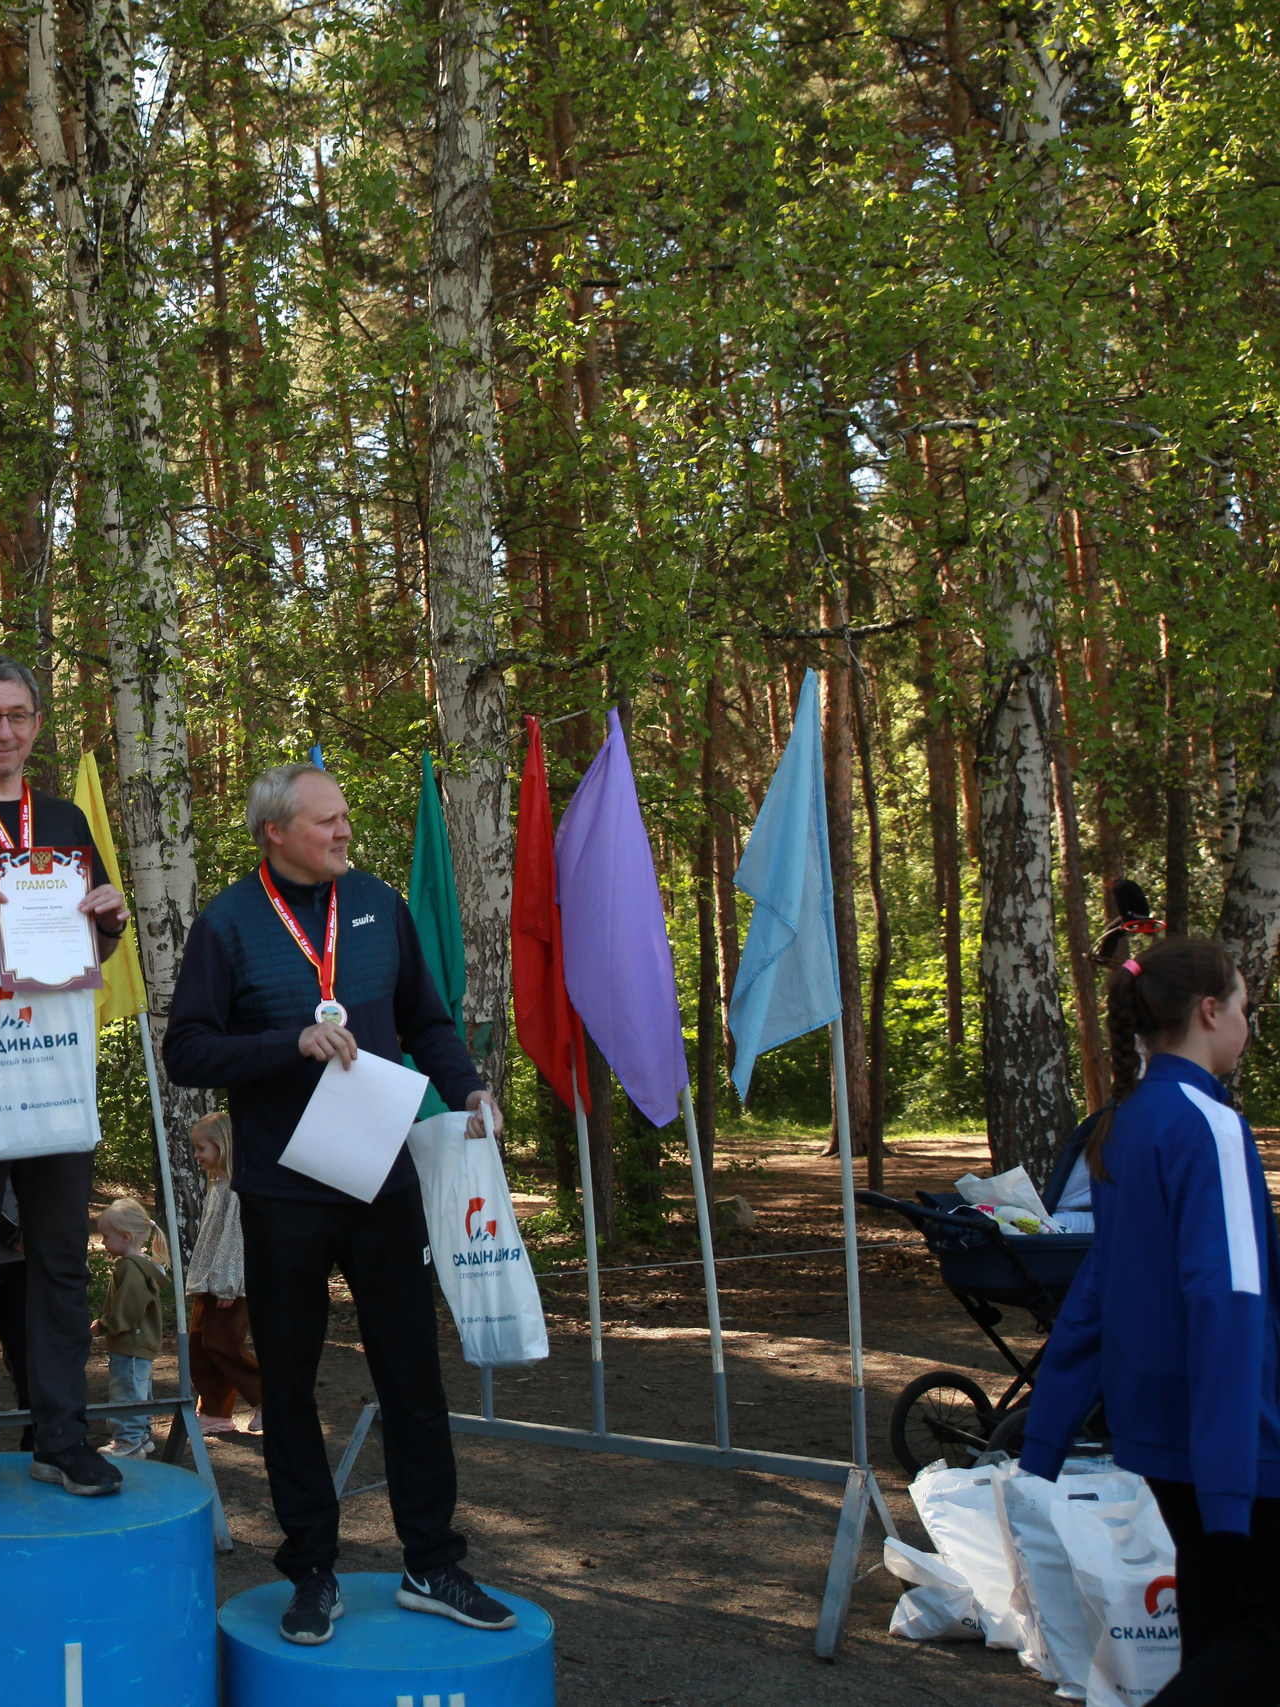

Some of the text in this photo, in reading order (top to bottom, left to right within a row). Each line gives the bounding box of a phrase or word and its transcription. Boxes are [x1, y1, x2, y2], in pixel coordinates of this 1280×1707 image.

[16, 879, 68, 890] ГРАМОТА
[22, 1056, 54, 1064] магазин
[28, 1098, 84, 1109] skandinavia74.ru
[1110, 1626, 1180, 1640] СКАНДИ
